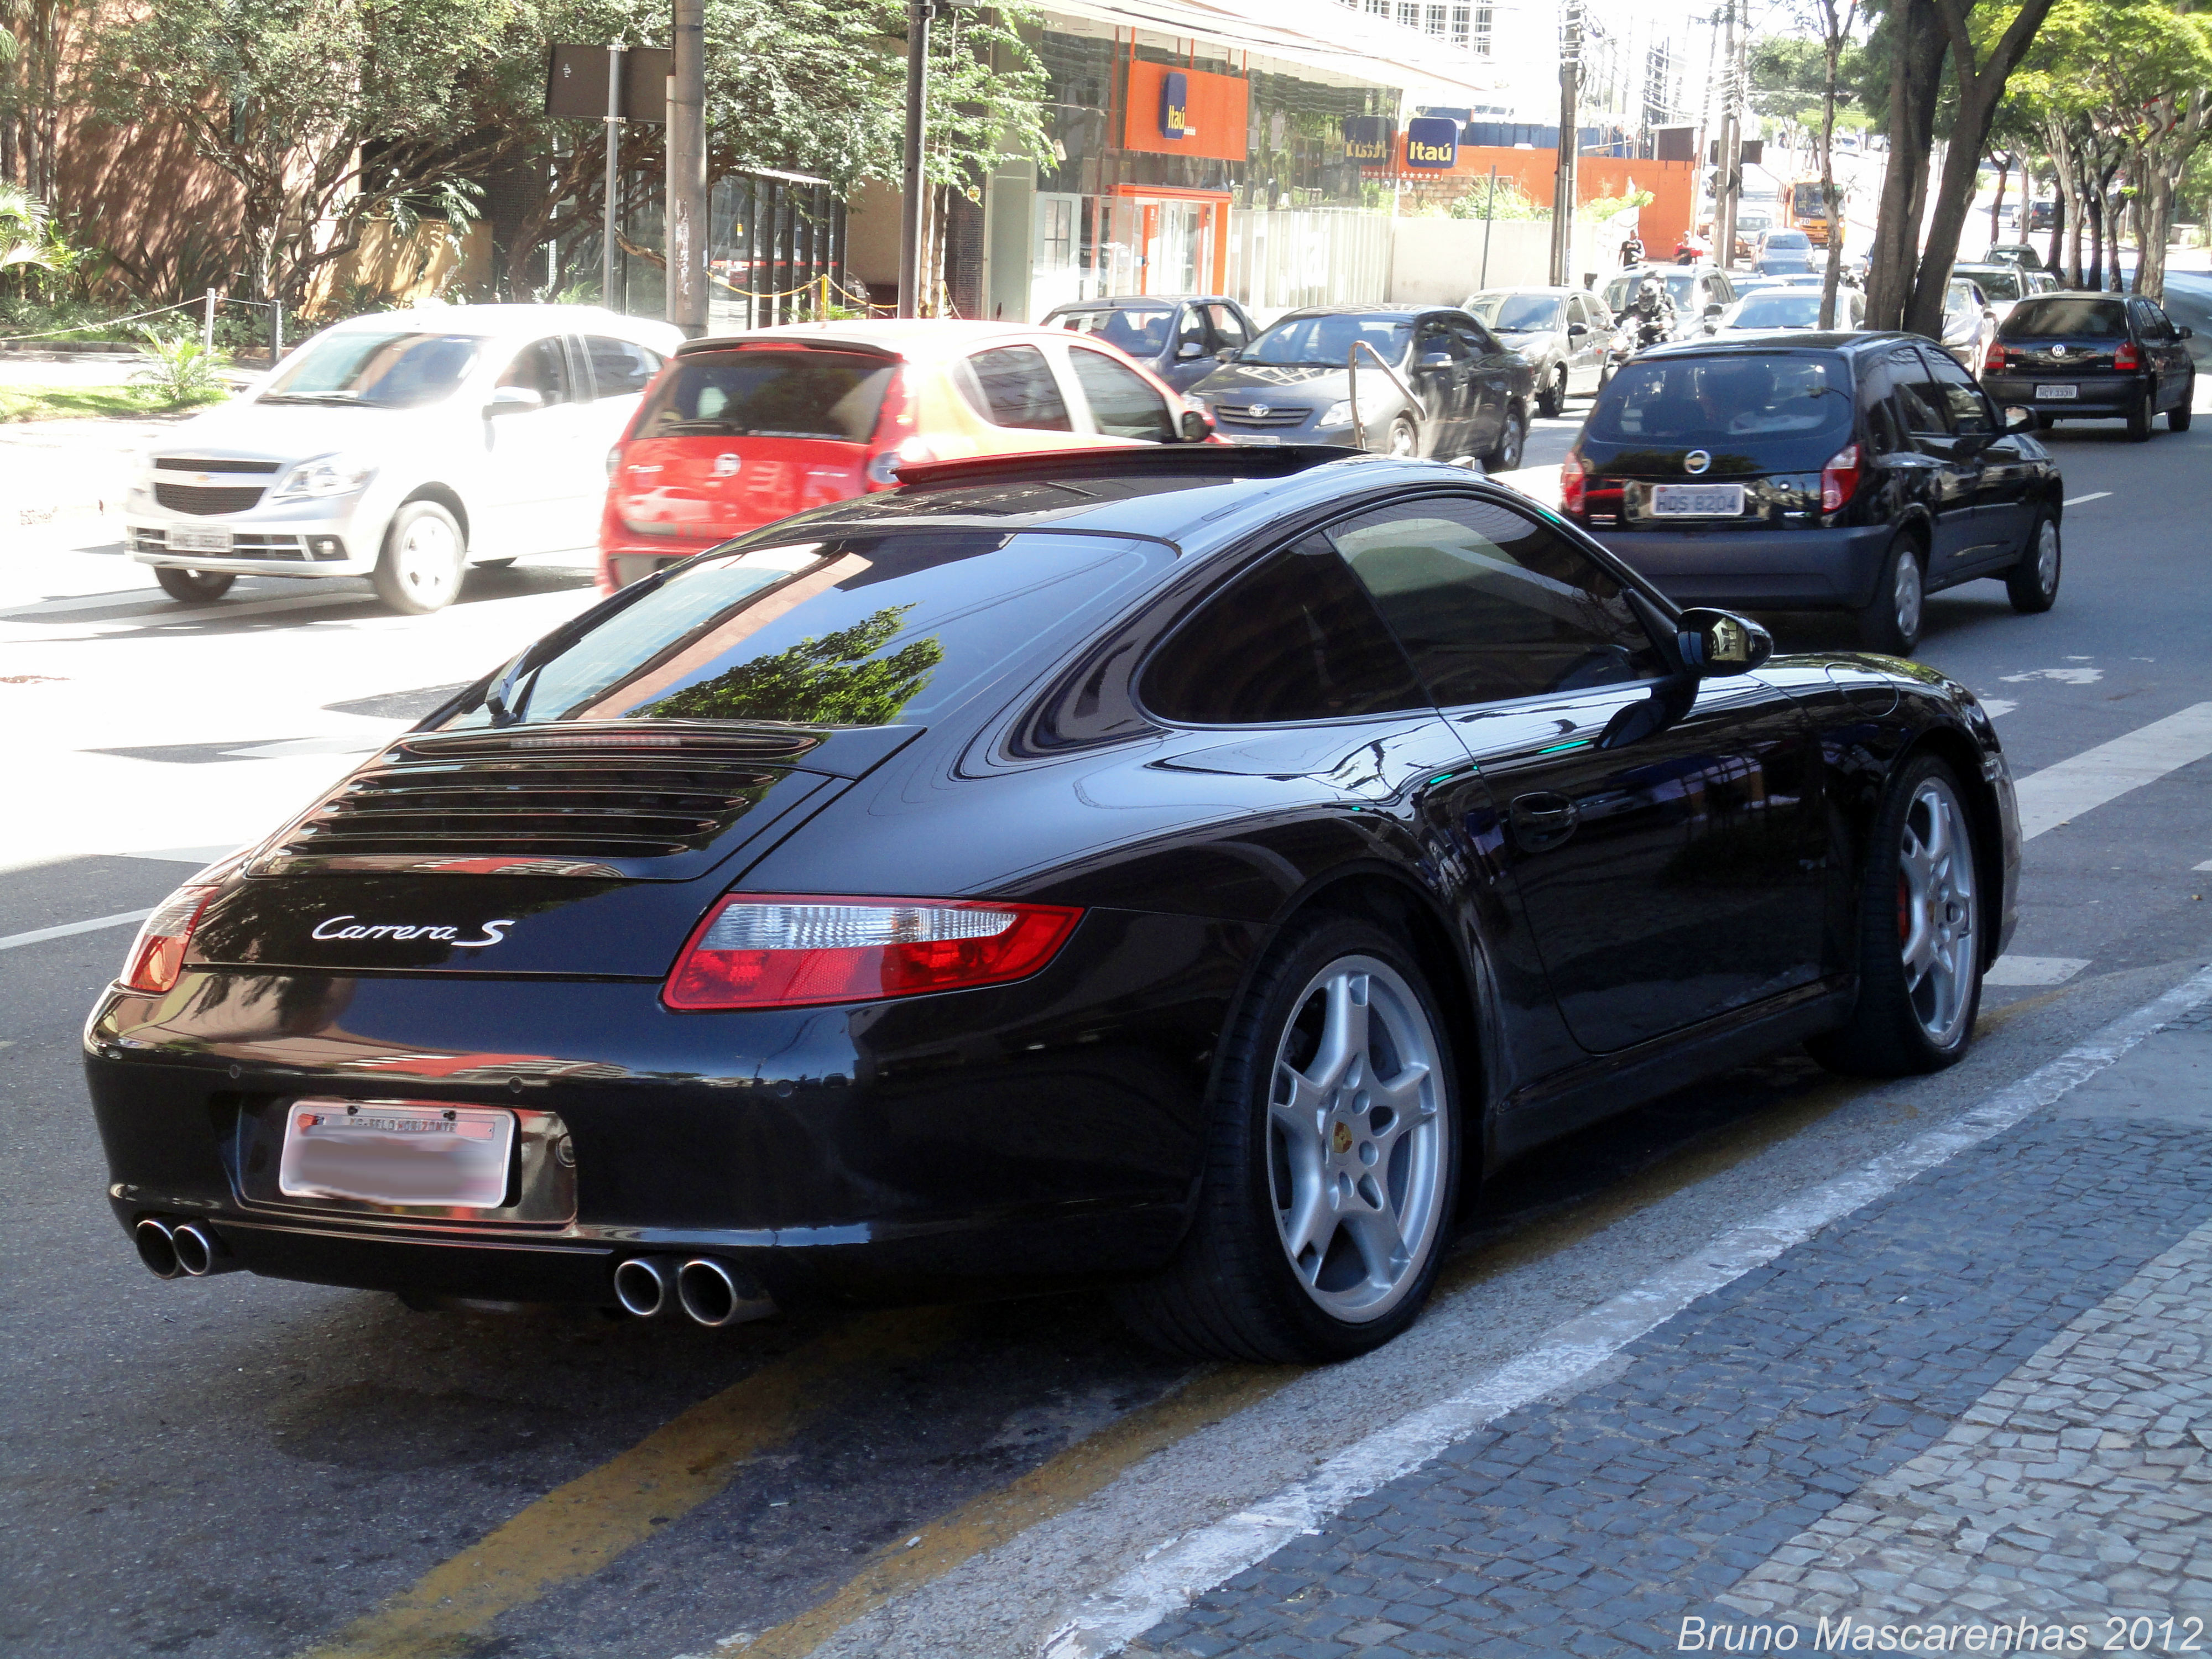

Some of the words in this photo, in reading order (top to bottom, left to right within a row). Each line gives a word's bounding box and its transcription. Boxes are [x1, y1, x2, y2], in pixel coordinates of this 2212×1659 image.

[1167, 105, 1185, 129] Itaú
[1409, 141, 1453, 161] Itaú
[1695, 495, 1737, 511] 8204
[312, 915, 458, 940] Carrera
[450, 920, 516, 947] S
